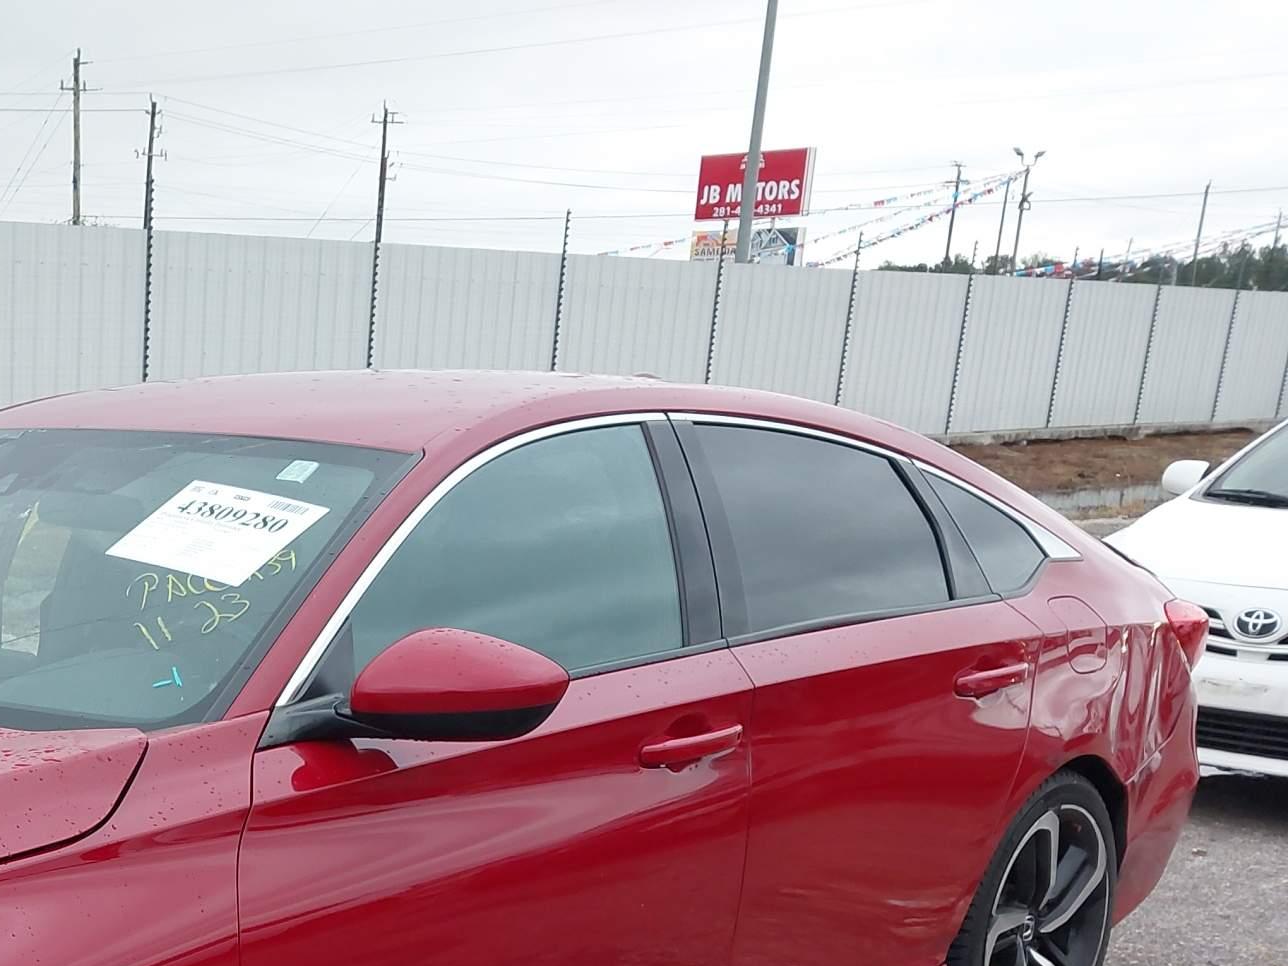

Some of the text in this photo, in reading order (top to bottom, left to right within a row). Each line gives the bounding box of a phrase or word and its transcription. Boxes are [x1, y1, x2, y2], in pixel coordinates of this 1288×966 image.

[701, 180, 800, 205] JB MTORS
[713, 204, 782, 217] 281-4-4341
[177, 499, 289, 534] 43809280
[193, 592, 250, 634] 23
